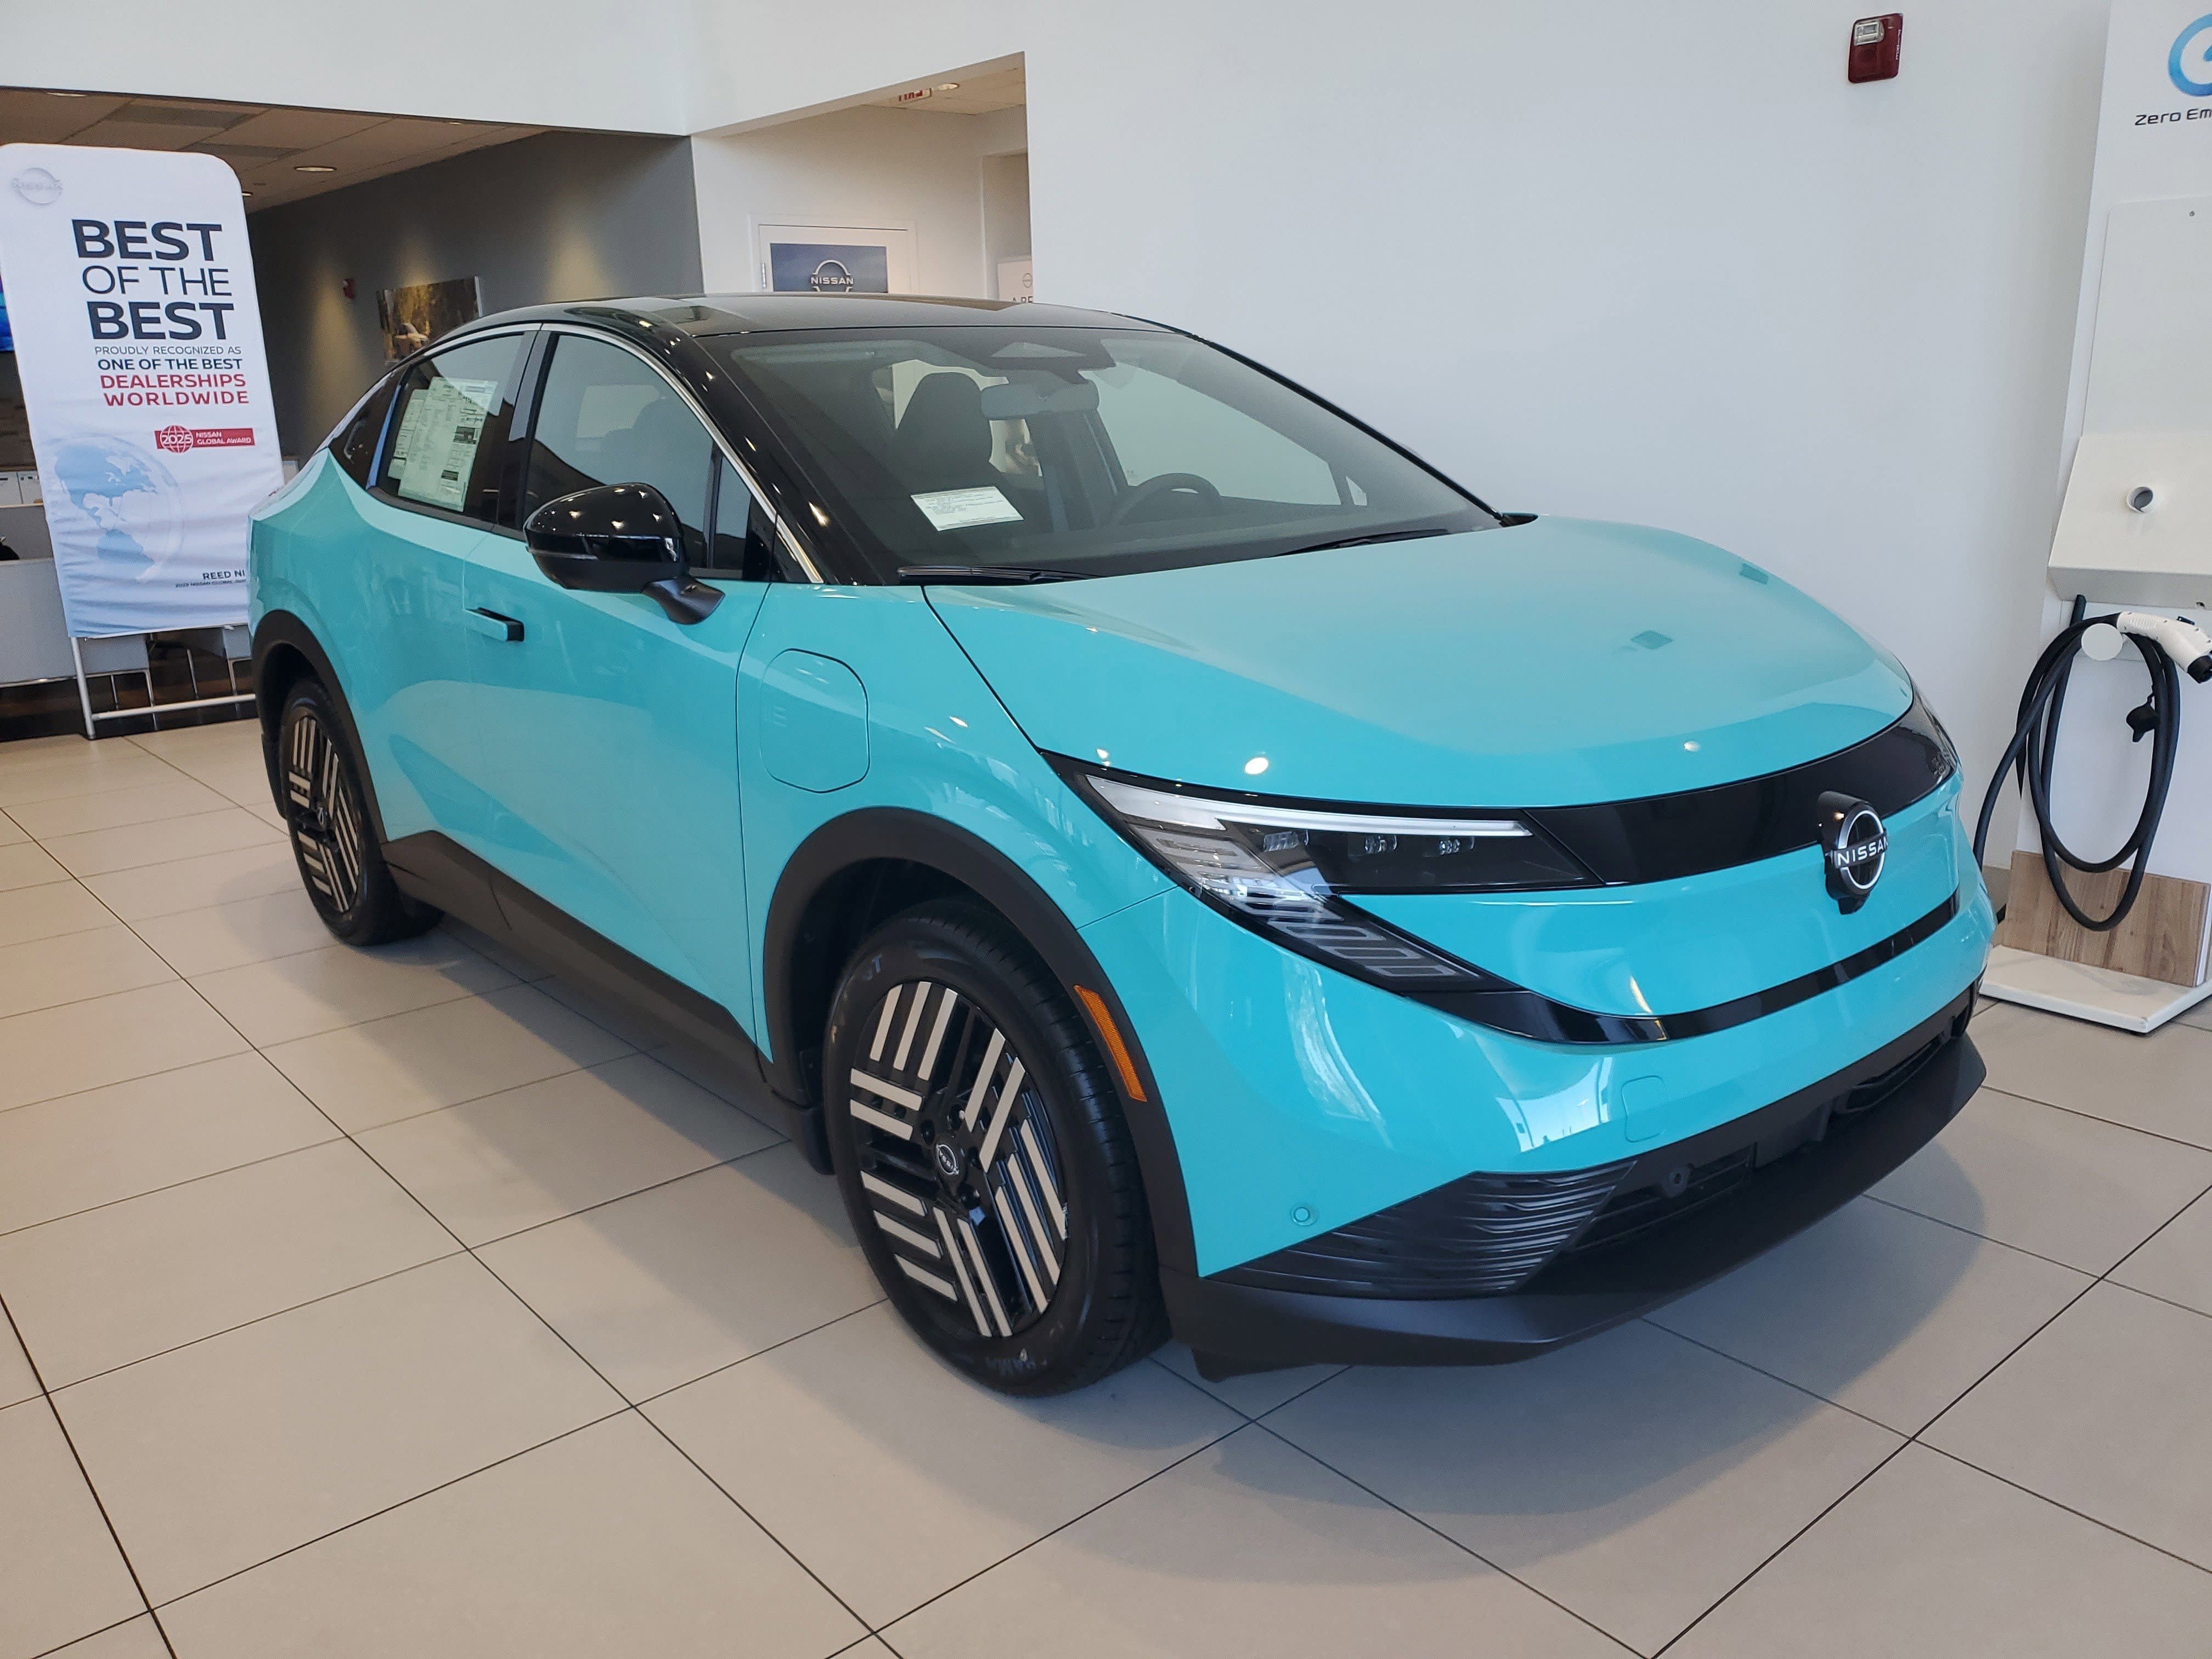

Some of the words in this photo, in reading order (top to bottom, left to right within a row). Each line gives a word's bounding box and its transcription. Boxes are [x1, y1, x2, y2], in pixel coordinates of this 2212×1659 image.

[2135, 112, 2181, 126] Zero
[71, 219, 223, 261] BEST
[82, 265, 140, 294] OF
[148, 266, 232, 296] THE
[810, 276, 854, 285] NISSAN
[86, 301, 234, 340] BEST
[94, 346, 149, 355] PROUDLY
[153, 346, 224, 355] RECOGNIZED
[228, 346, 241, 354] AS
[98, 359, 136, 370] ONE
[138, 359, 161, 370] OF
[165, 358, 199, 370] THE
[201, 358, 242, 370] BEST
[100, 374, 246, 388] DEALERSHIPS
[103, 391, 249, 406] WORLDWIDE
[161, 433, 192, 445] 2025
[202, 571, 231, 580] REED
[1838, 836, 1889, 866] NISSAN
